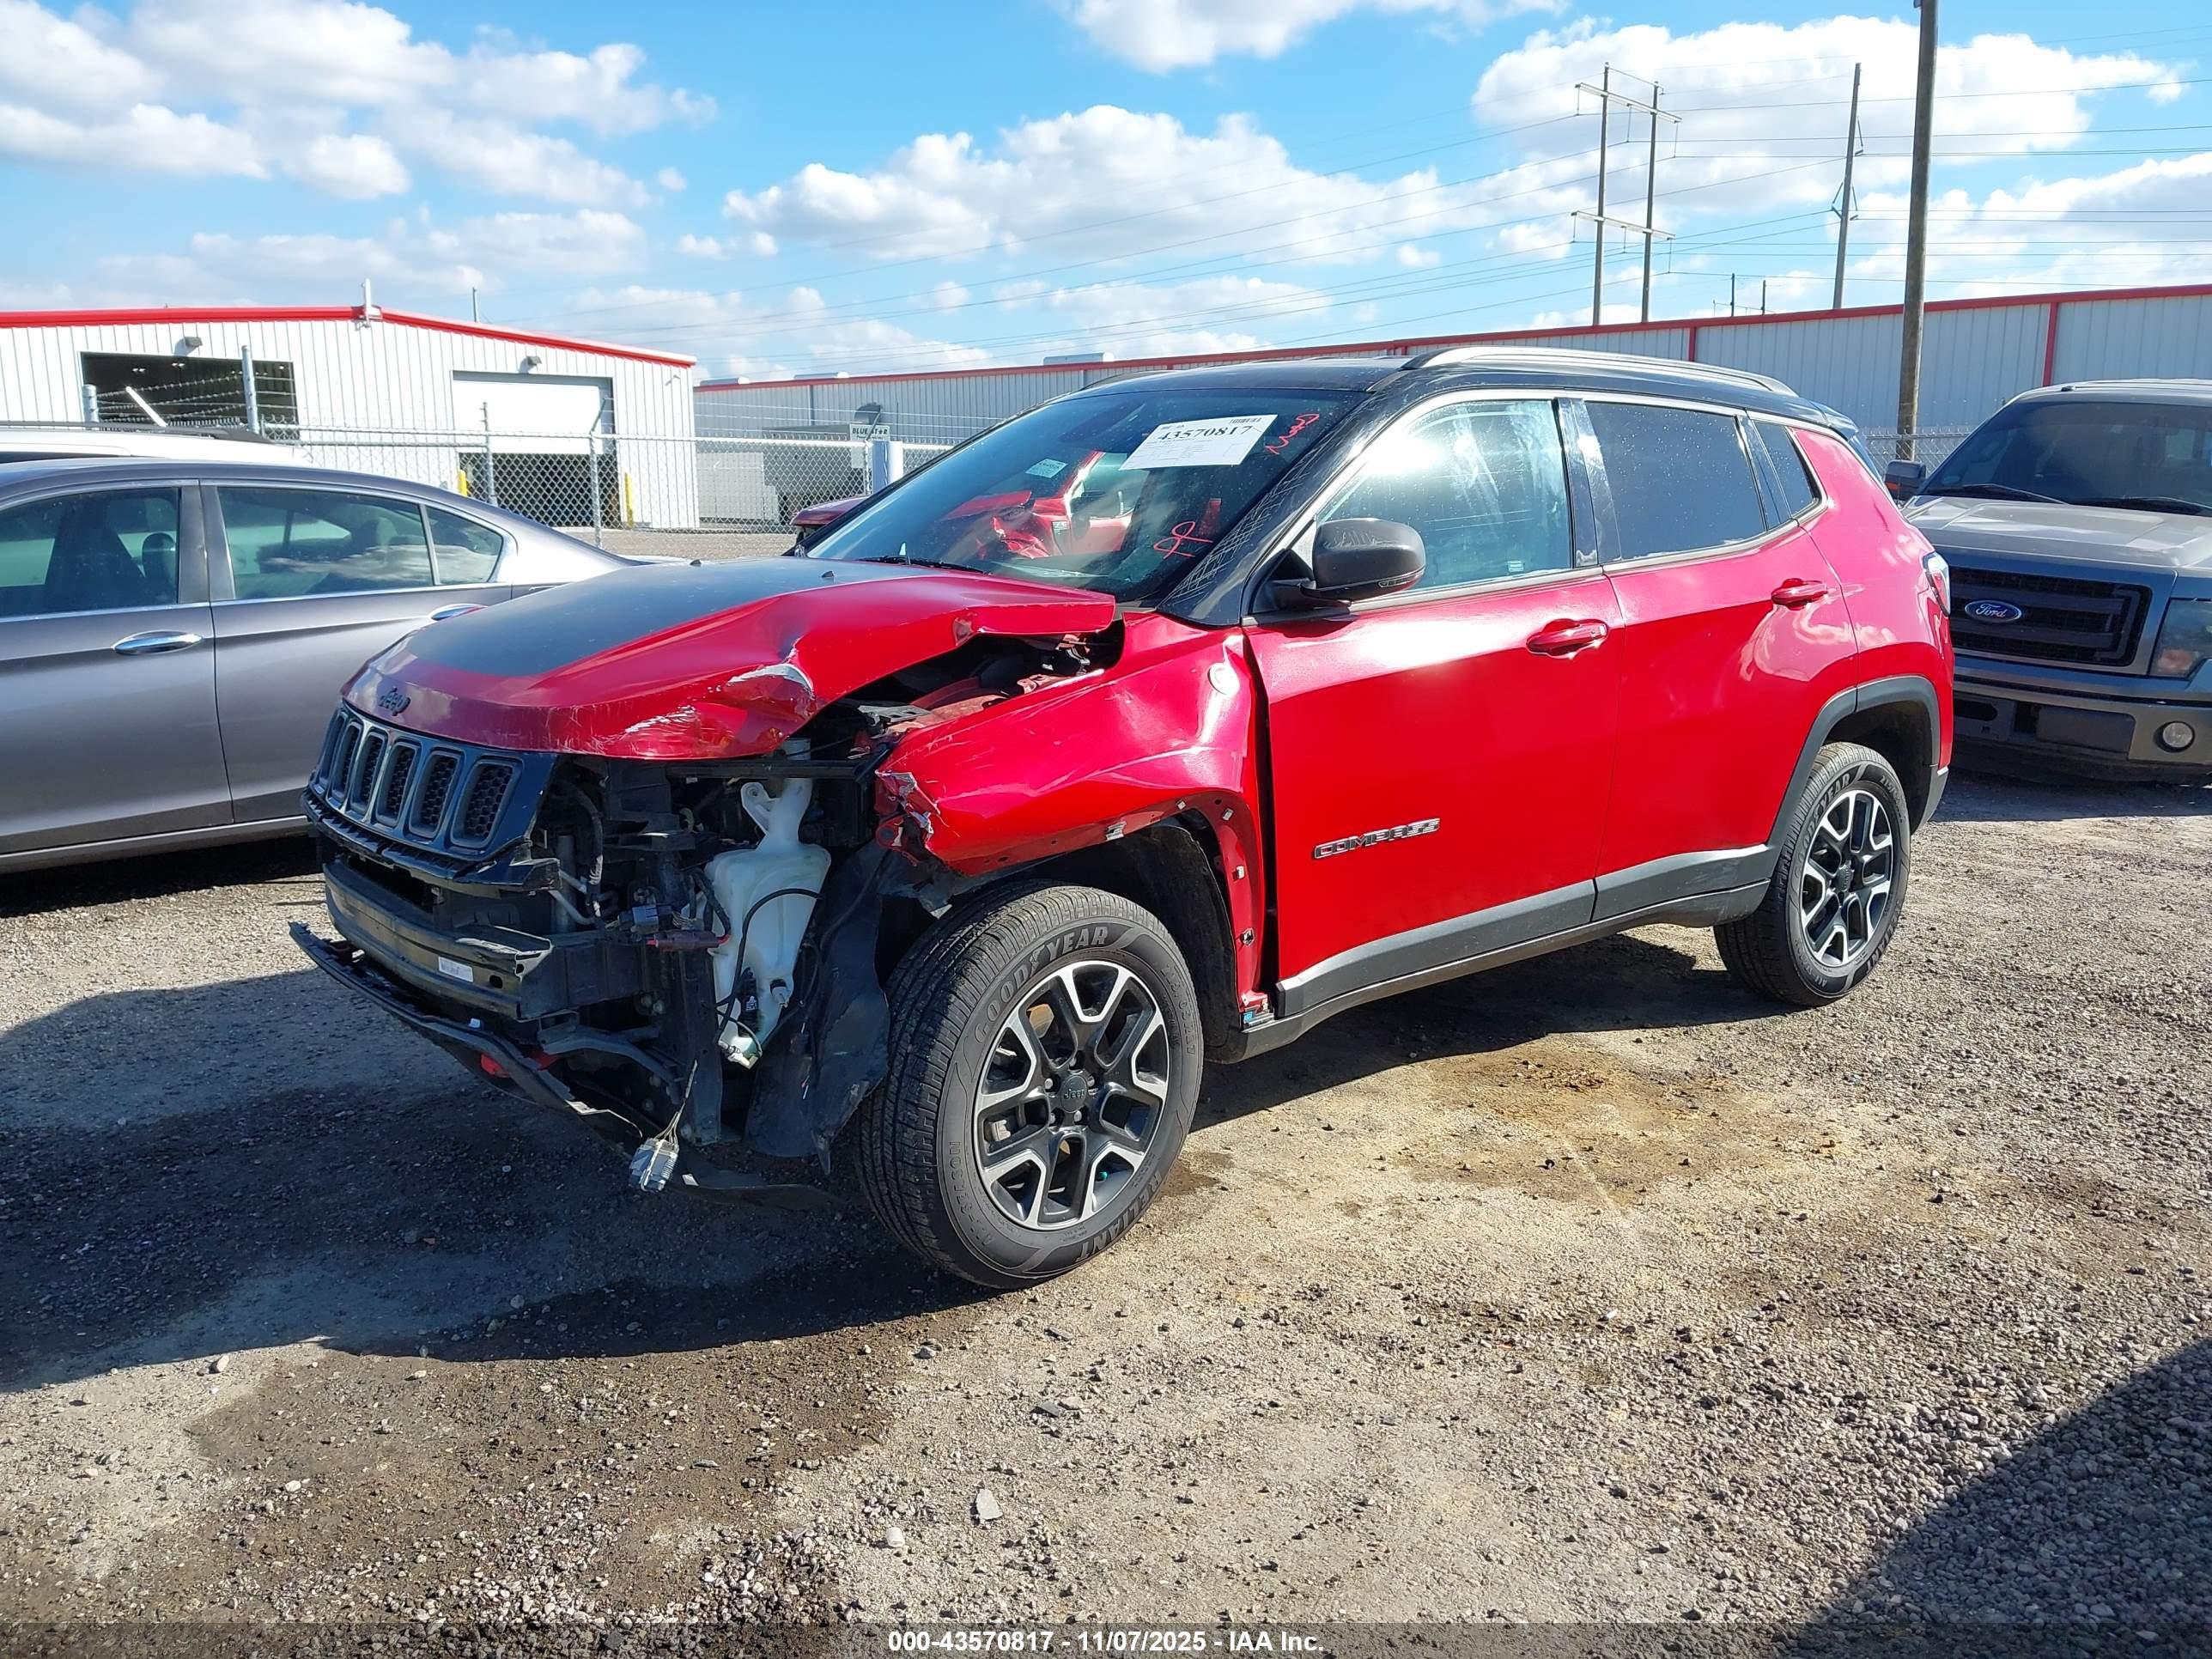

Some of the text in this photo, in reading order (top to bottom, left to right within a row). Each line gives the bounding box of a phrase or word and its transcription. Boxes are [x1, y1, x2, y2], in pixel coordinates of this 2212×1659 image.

[1158, 426, 1254, 441] 43570817
[1975, 603, 2008, 619] Ford
[378, 687, 411, 717] Jeep
[1314, 817, 1441, 860] COMPASS
[974, 926, 1109, 1043] GOODYEAR
[1063, 1088, 1086, 1100] Jeep
[1074, 1170, 1163, 1263] RELIANT
